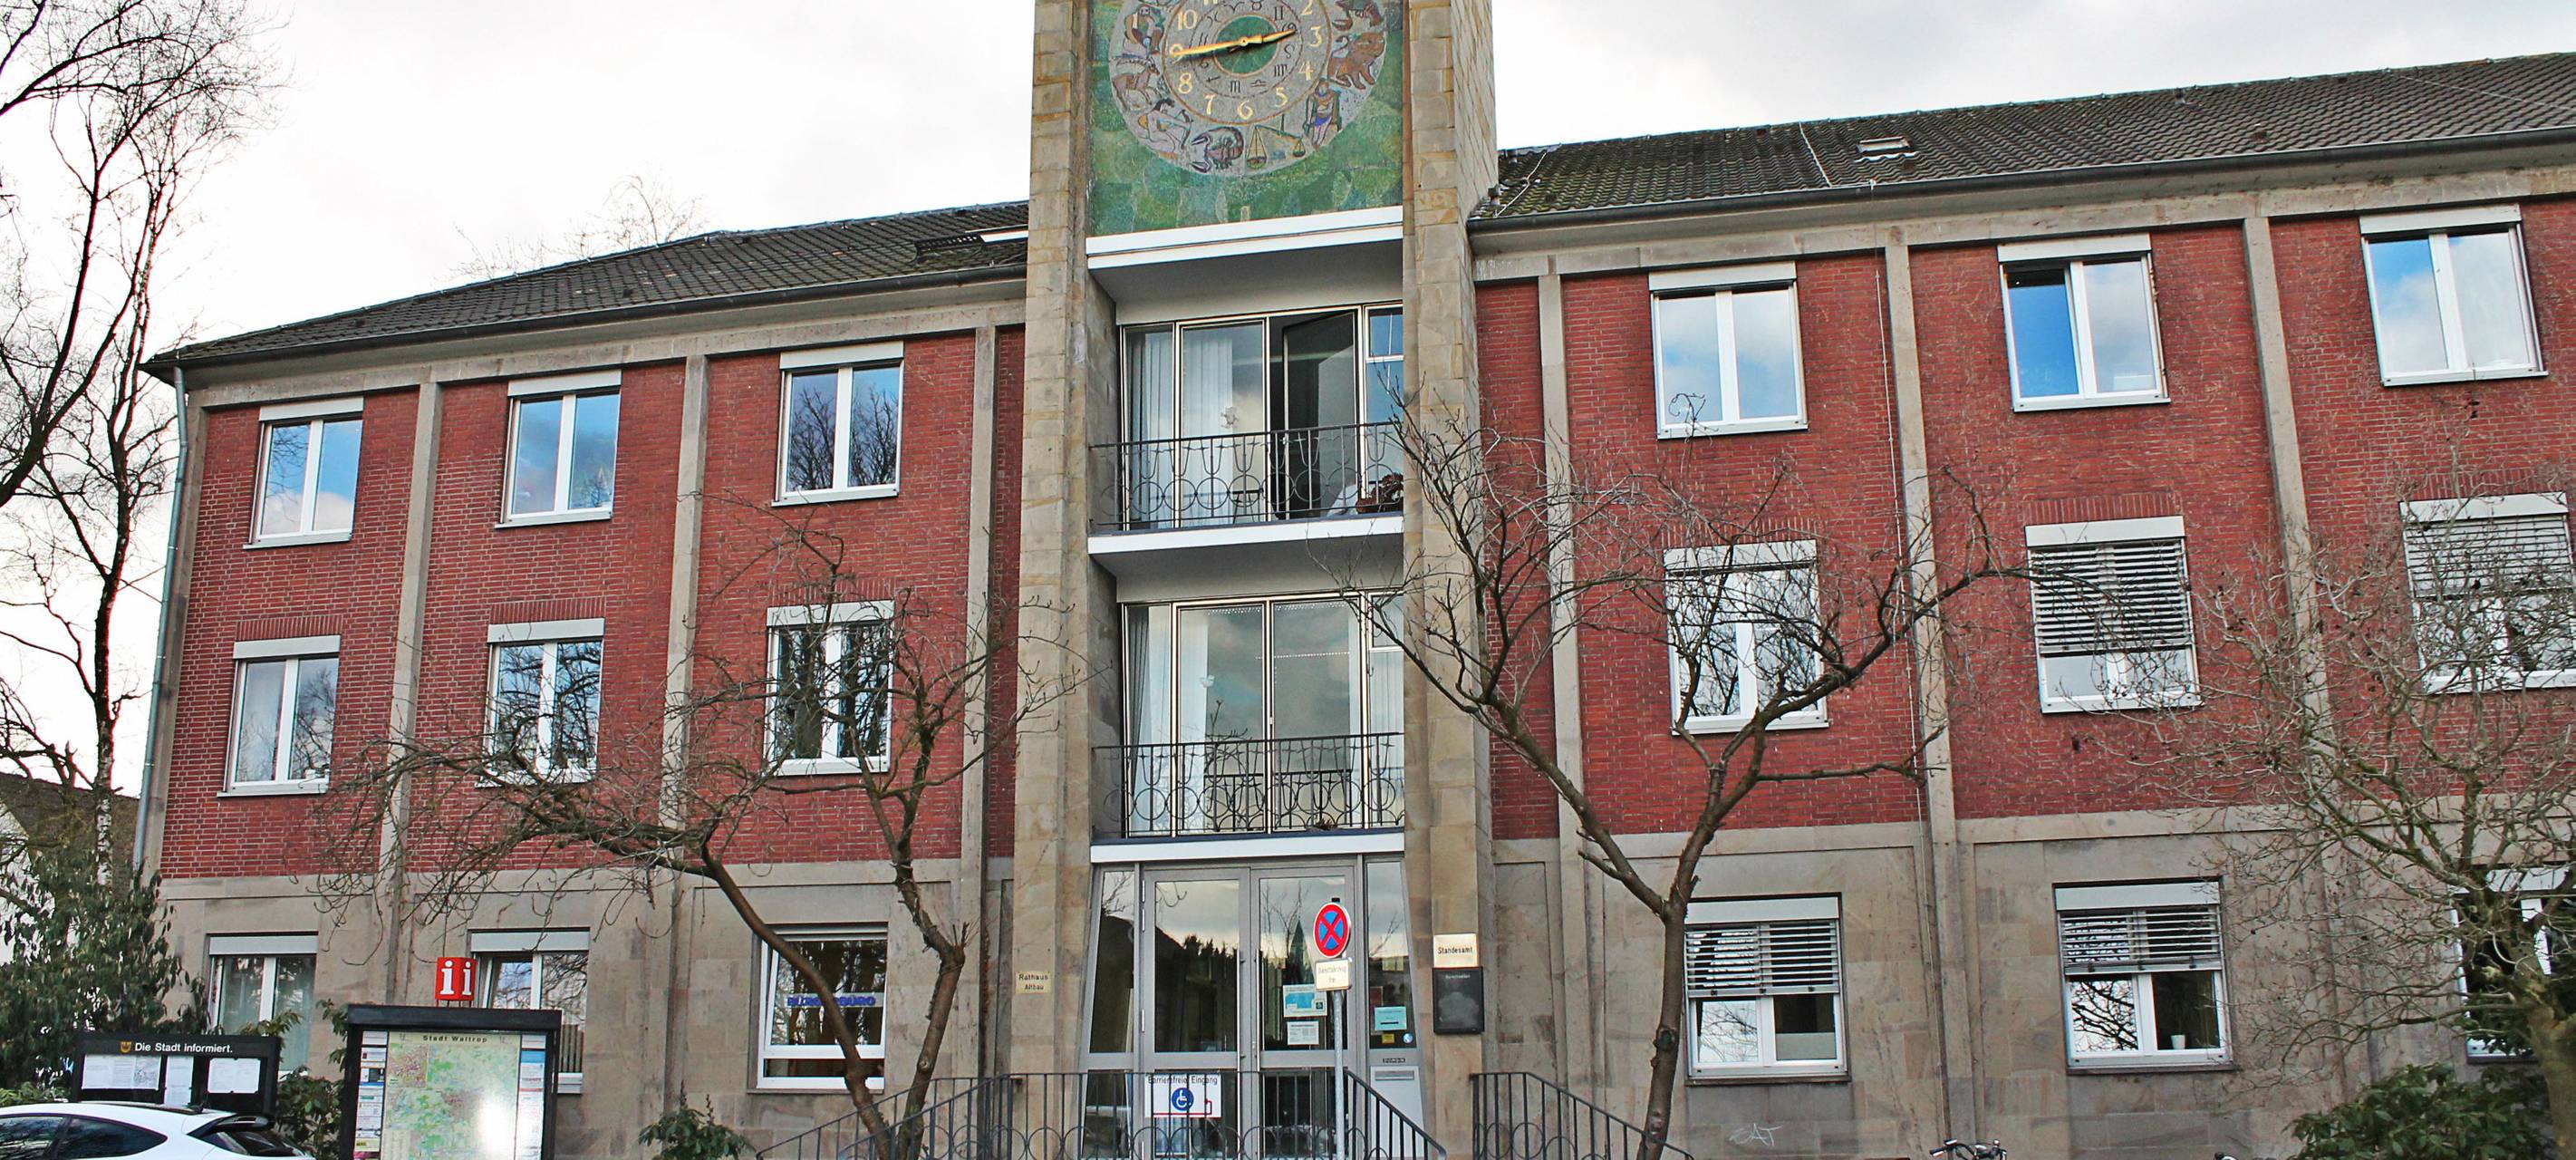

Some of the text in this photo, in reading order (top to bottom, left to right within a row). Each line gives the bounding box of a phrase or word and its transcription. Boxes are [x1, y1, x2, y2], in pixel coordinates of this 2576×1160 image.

[1300, 0, 1314, 15] 2
[1177, 9, 1198, 30] 10
[1309, 25, 1323, 47] 3
[1298, 61, 1314, 81] 4
[1178, 72, 1193, 94] 8
[1203, 94, 1216, 115] 7
[1275, 86, 1288, 108] 5
[1237, 101, 1254, 121] 6
[1437, 946, 1473, 954] Standesamt
[439, 960, 454, 995] i
[462, 961, 472, 995] i
[787, 994, 876, 1007] BÜRGBÜRO
[135, 1042, 233, 1053] Die Stadt informiert.
[423, 1034, 448, 1042] Stadt
